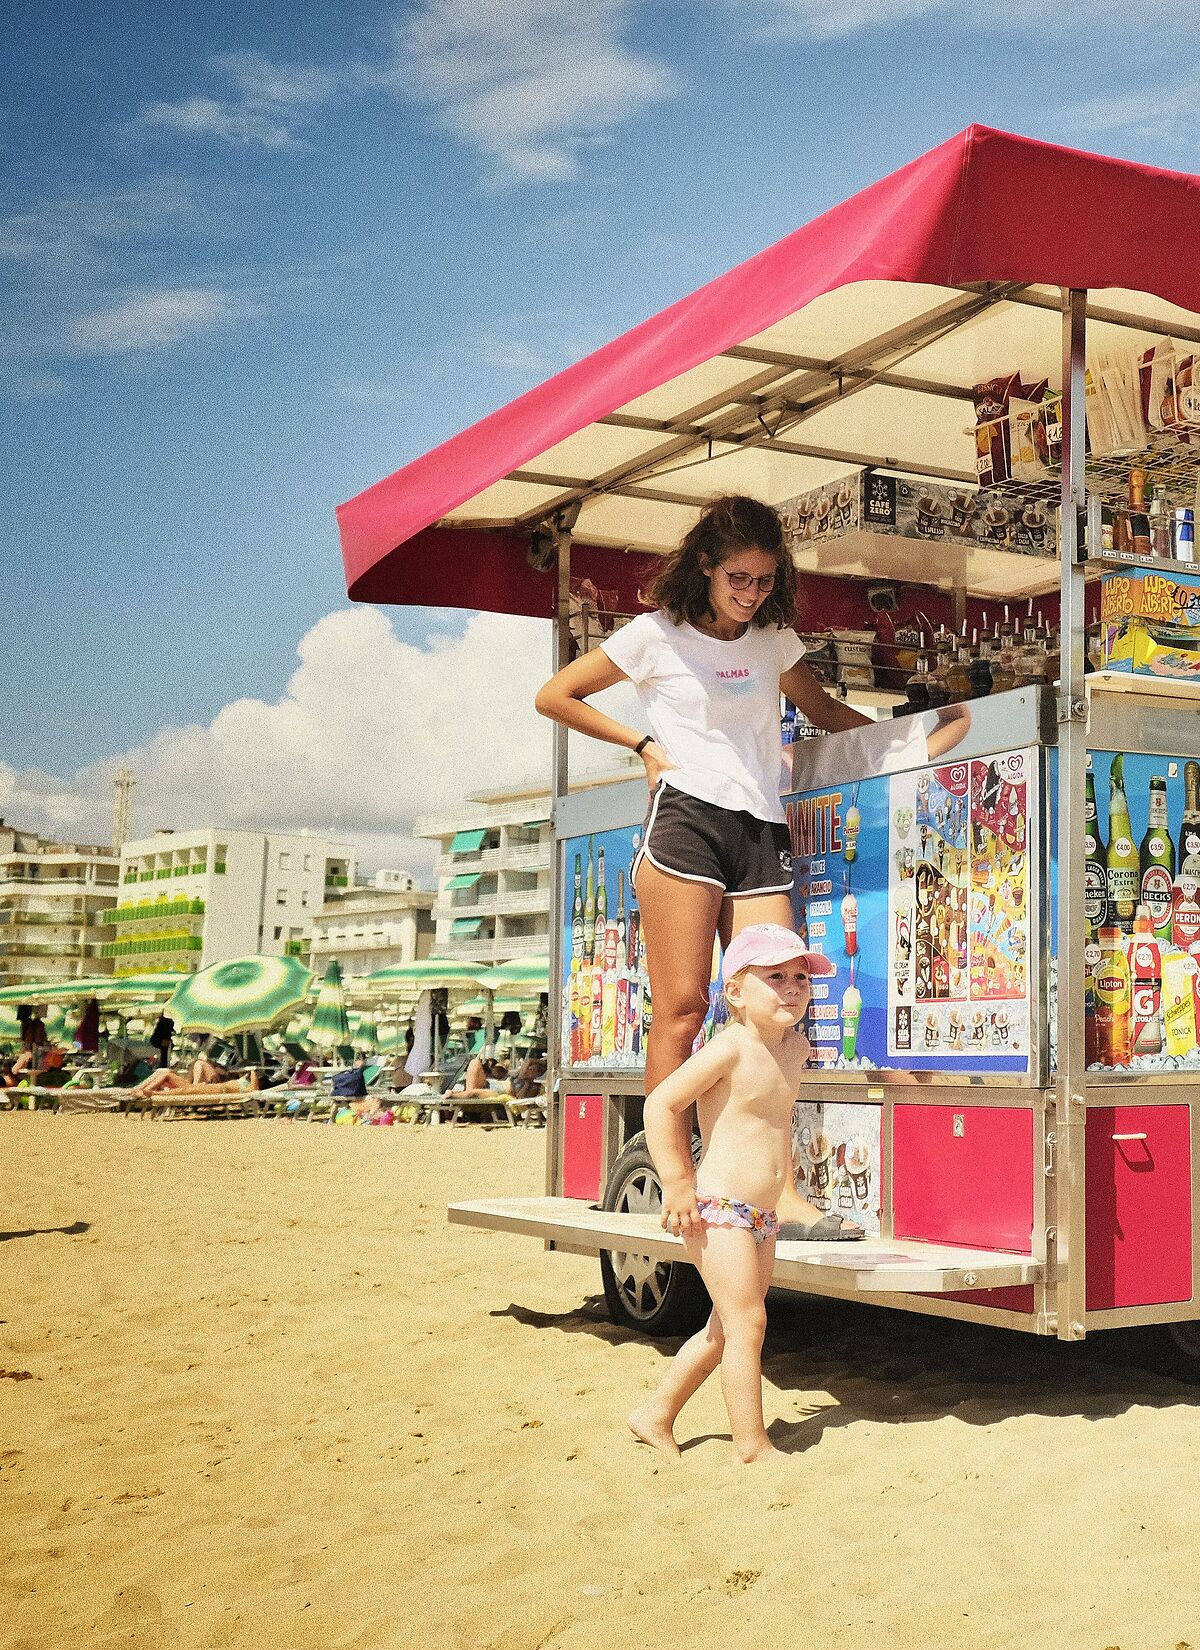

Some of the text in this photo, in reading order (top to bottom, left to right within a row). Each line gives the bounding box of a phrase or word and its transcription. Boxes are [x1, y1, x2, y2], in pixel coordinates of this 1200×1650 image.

[1143, 575, 1178, 596] LUPO
[715, 668, 750, 679] PALMAS
[1116, 843, 1131, 852] €4,00
[1150, 843, 1164, 852] €3,50
[1186, 840, 1200, 849] €3,50
[1107, 869, 1139, 880] Corona
[1182, 883, 1196, 891] €2,70
[1143, 891, 1172, 901] BECK'S
[1085, 950, 1100, 958] €2,70
[1099, 979, 1123, 989] Lipton
[1134, 989, 1154, 1016] G
